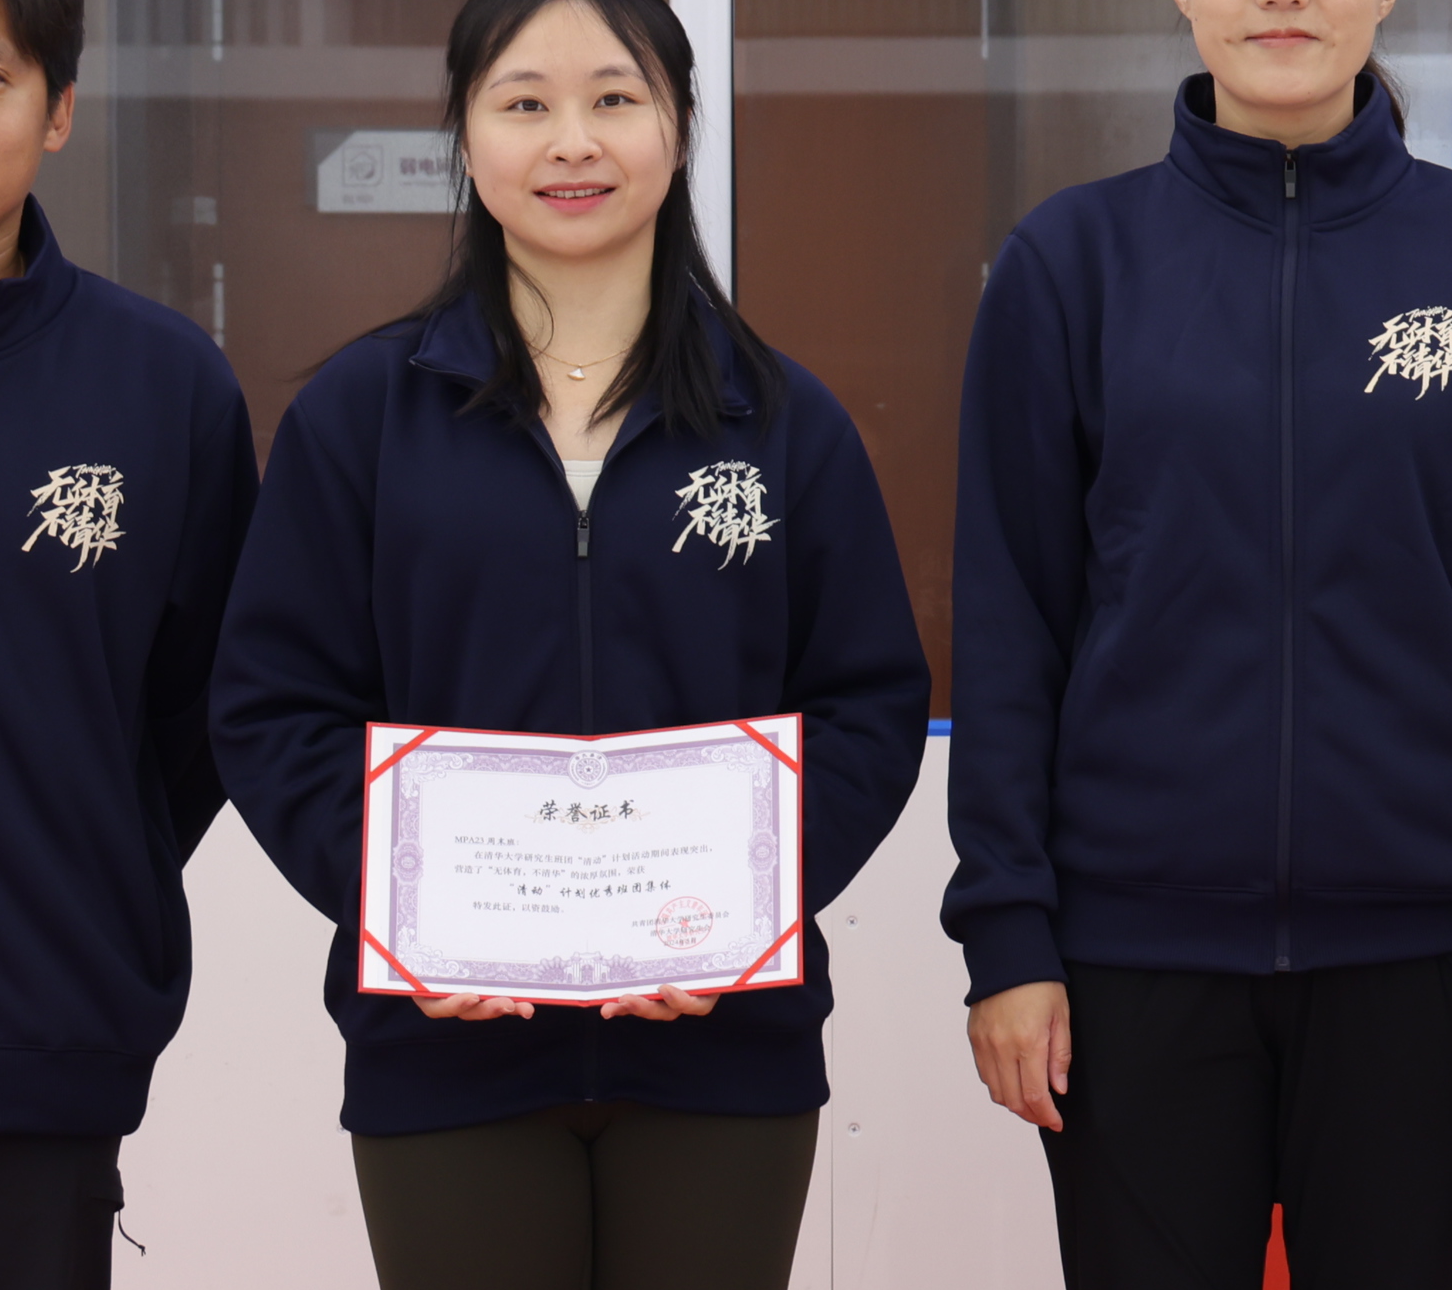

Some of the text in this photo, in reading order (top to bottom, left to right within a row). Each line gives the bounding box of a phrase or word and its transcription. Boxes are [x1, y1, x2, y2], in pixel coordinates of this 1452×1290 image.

[26, 466, 124, 523] 无体育
[671, 465, 767, 521] 无体育
[21, 505, 127, 573] 不清华
[671, 501, 781, 570] 不清华
[538, 799, 636, 823] 荣誉证书
